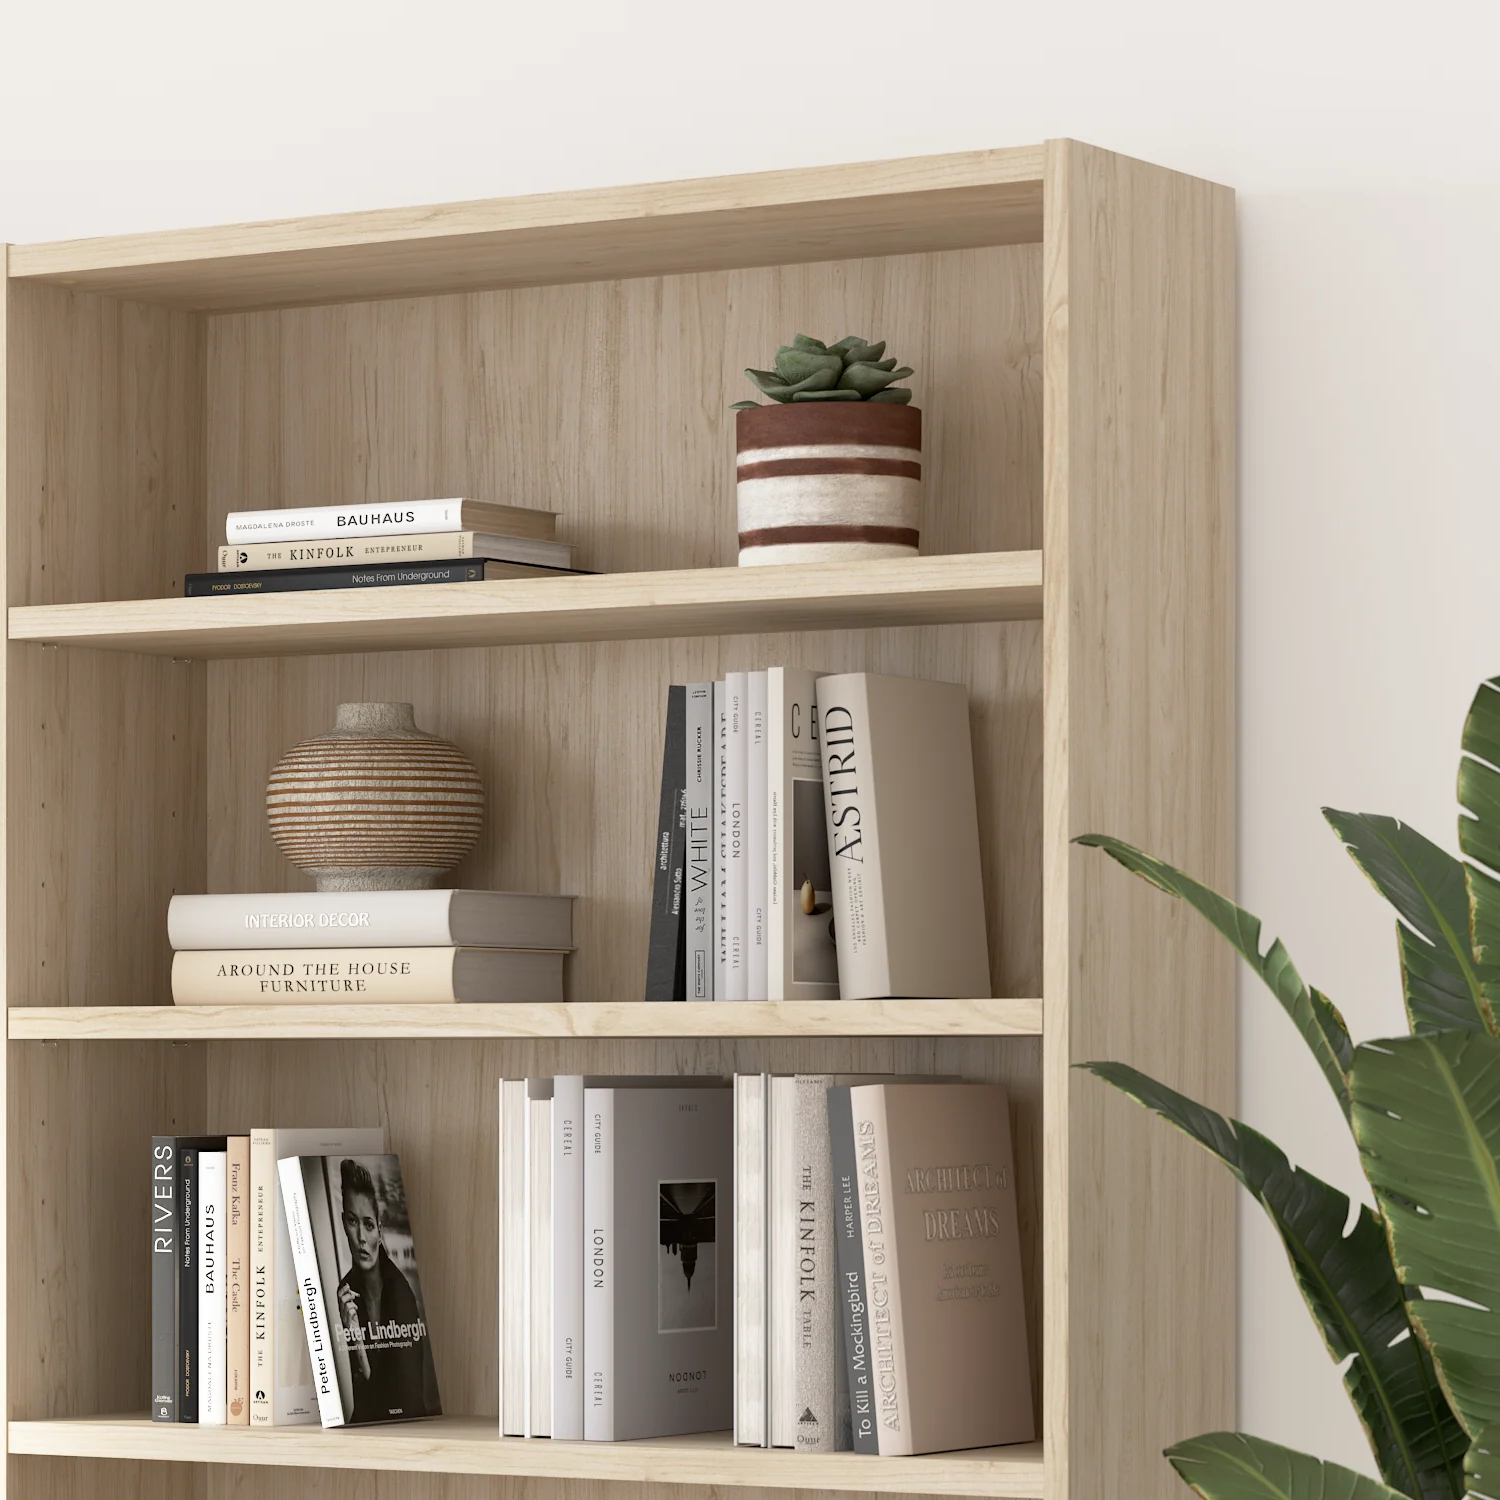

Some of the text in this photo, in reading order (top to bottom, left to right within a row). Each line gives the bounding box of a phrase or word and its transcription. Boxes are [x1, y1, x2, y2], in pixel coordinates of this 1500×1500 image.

[336, 511, 415, 527] BAUHAUS
[290, 546, 354, 560] KINFOLK
[352, 570, 450, 584] Notes From Underground
[825, 706, 863, 864] ÆSTRID
[690, 806, 708, 892] WHITE
[732, 803, 740, 858] LONDON
[244, 912, 370, 928] INTERIOR DECOR
[216, 962, 411, 976] AROUND THE HOUSE
[260, 980, 367, 993] FURNITURE
[564, 1120, 573, 1156] CEREAL
[154, 1146, 172, 1253] RIVERS
[232, 1162, 240, 1192] Franz
[904, 1163, 992, 1194] ARCHITECT
[184, 1179, 192, 1226] Underground
[842, 1175, 856, 1238] HARPER LEE
[923, 1206, 1000, 1242] DREAMS
[205, 1204, 214, 1294] BAUHAUS
[800, 1166, 816, 1350] THE KINFOLK TABLE
[232, 1258, 240, 1312] The Castle
[856, 1121, 900, 1432] ARCHITECT DREAMS
[256, 1265, 266, 1340] KINFOLK
[594, 1229, 604, 1407] LONDON CEREAL
[304, 1277, 330, 1394] Peter Lindbergh
[334, 1318, 426, 1342] Peter Lindbergh
[846, 1272, 872, 1438] To Kill Mockingbird
[669, 1370, 707, 1382] LONDON
